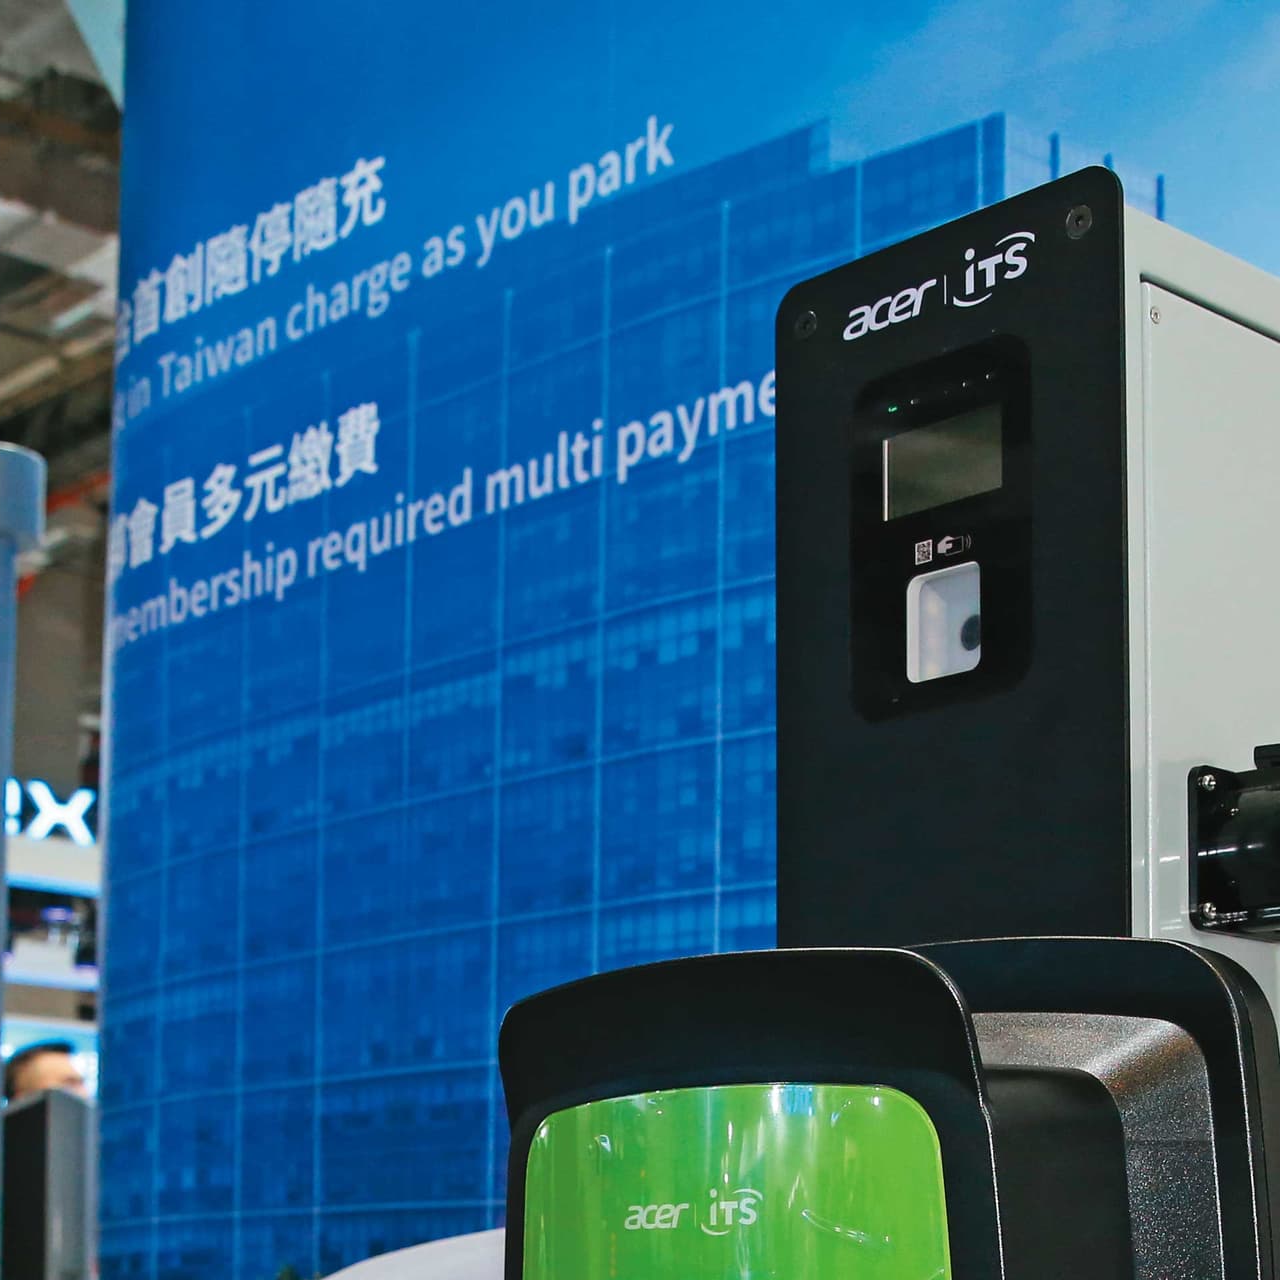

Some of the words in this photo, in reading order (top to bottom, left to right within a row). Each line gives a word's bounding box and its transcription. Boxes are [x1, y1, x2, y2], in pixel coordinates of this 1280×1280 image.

[157, 316, 277, 398] Taiwan
[285, 251, 412, 342] charge
[421, 224, 466, 279] as
[475, 179, 556, 269] you
[568, 114, 675, 226] park
[842, 278, 937, 341] acer
[306, 466, 473, 579] required
[484, 417, 604, 515] multi
[624, 1203, 690, 1231] acer
